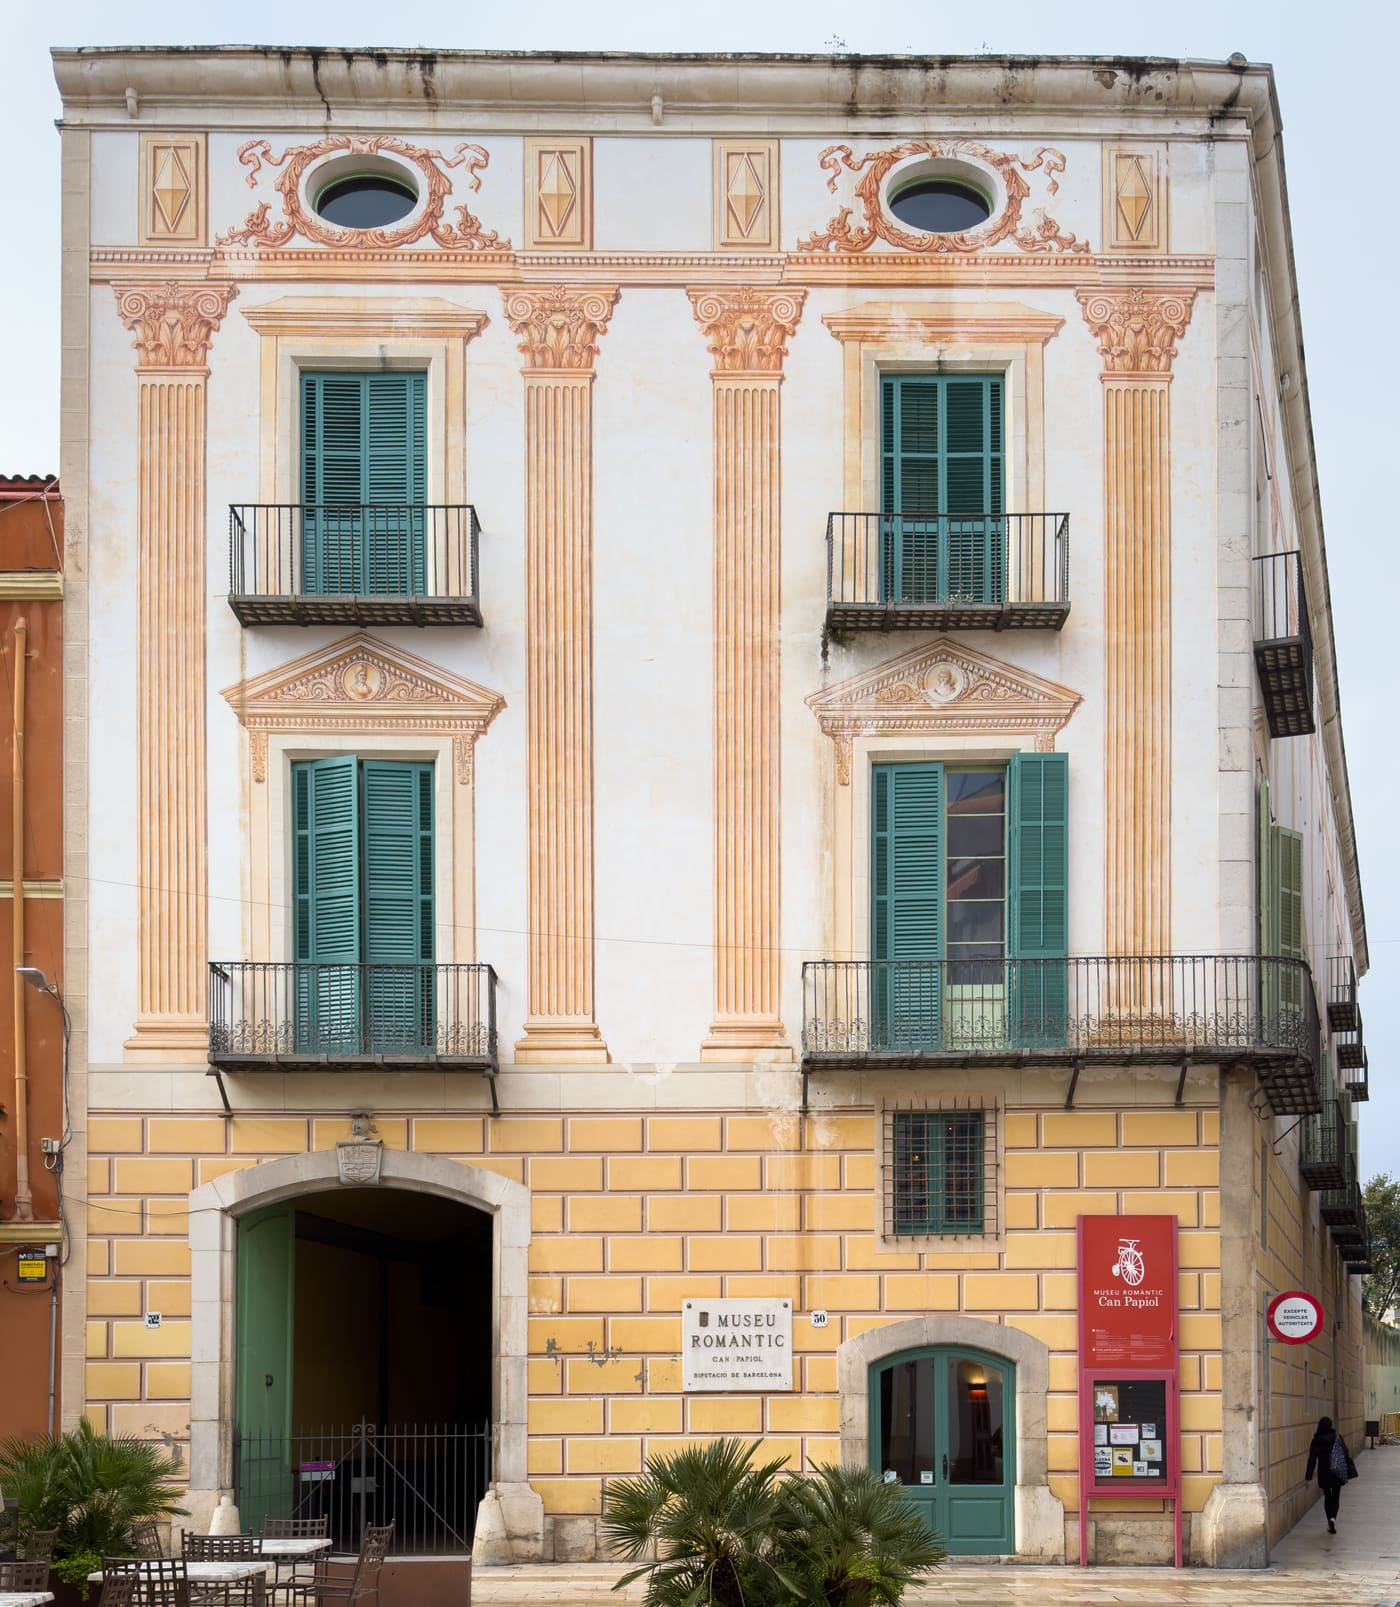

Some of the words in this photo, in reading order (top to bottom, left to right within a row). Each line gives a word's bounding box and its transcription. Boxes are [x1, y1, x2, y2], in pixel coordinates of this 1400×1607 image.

[1098, 1296, 1121, 1307] Can
[1124, 1296, 1159, 1309] Papiol
[718, 1314, 775, 1327] MUSEU
[691, 1332, 784, 1347] ROMÀNTIC
